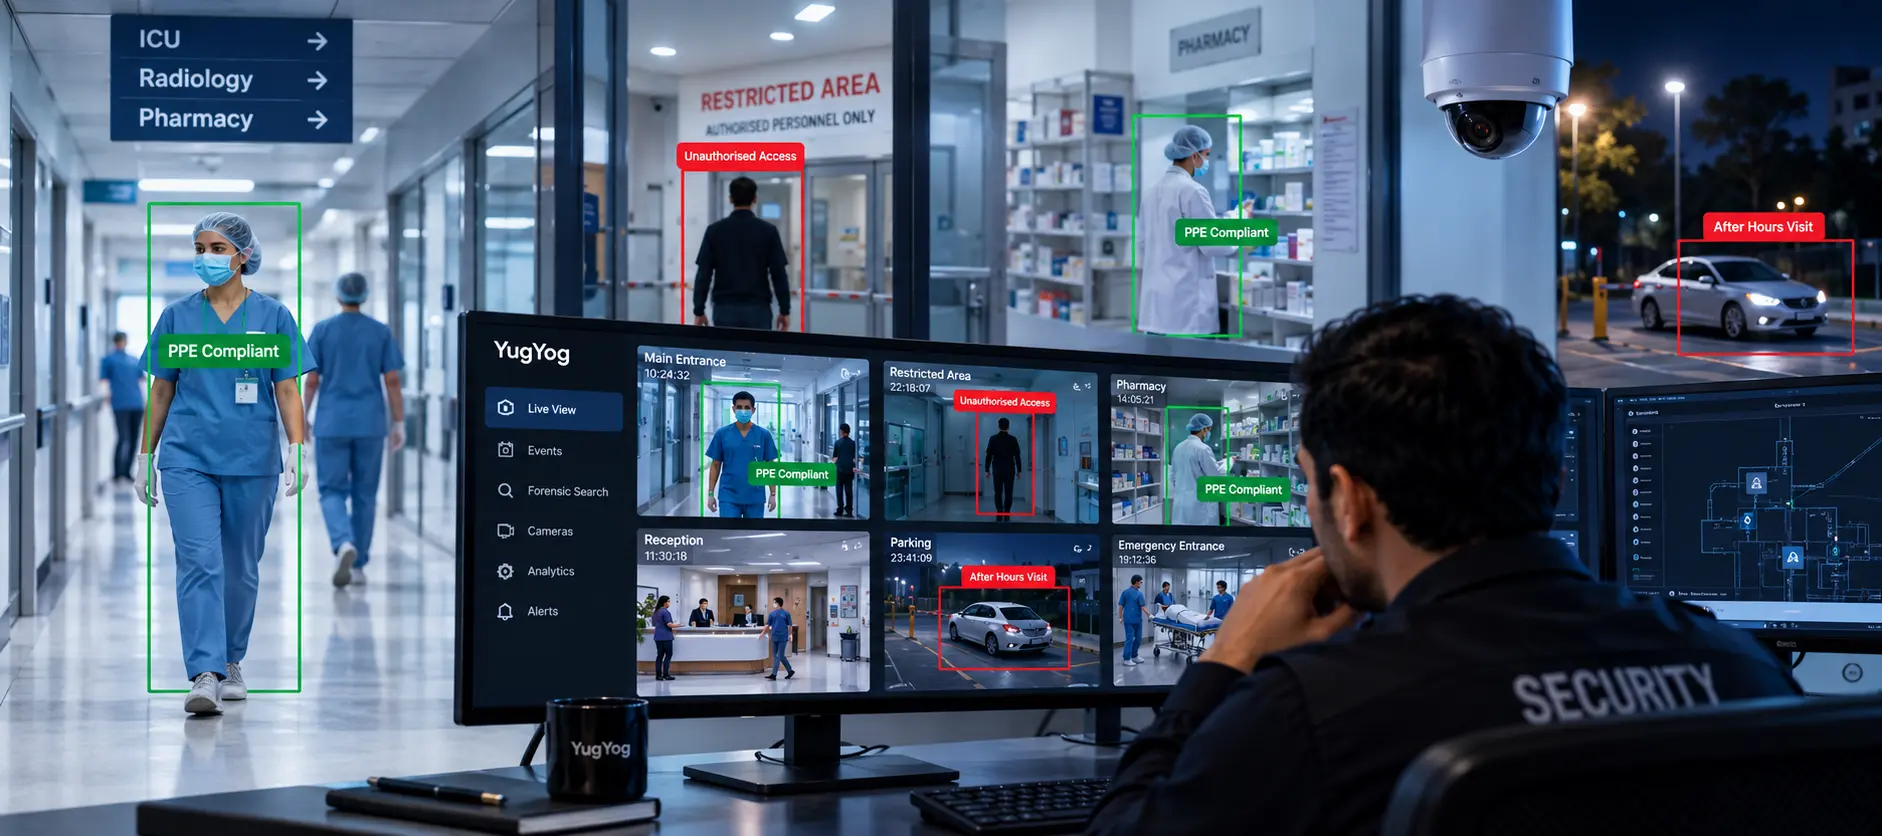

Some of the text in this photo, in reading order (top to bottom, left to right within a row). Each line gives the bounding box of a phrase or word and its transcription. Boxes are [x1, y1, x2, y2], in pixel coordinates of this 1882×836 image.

[140, 30, 180, 48] ICU
[1178, 24, 1250, 56] PHARMACY
[140, 68, 253, 92] Radiology
[701, 72, 880, 111] RESTRICTED AREA
[140, 108, 253, 132] Pharmacy
[706, 110, 875, 136] AUTHORISED PERSONNEL ONLY
[494, 341, 569, 366] YugYog
[645, 352, 726, 367] Main Entrance
[890, 367, 971, 380] Restricted Area
[890, 383, 930, 392] 22:18:07
[1117, 380, 1166, 393] Pharmacy
[960, 396, 1050, 407] Unauthorised Access
[529, 404, 576, 414] Live View
[529, 446, 562, 455] Events
[756, 469, 828, 480] PPE Compliant
[529, 486, 608, 496] Forensic Search
[1206, 484, 1282, 496] PPE Compliant
[528, 526, 573, 536] Cameras
[645, 534, 703, 547] Reception
[891, 537, 931, 550] Parking
[1119, 540, 1224, 552] Emergency Entrance
[645, 551, 687, 561] 11:30:18
[891, 553, 932, 562] 23:41:09
[1119, 555, 1156, 564] 19:12:36
[528, 566, 574, 578] Analytics
[970, 572, 1047, 581] After Hours Visit
[528, 606, 558, 616] Alerts
[1514, 663, 1719, 725] SECURITY
[572, 742, 630, 759] YugYog
